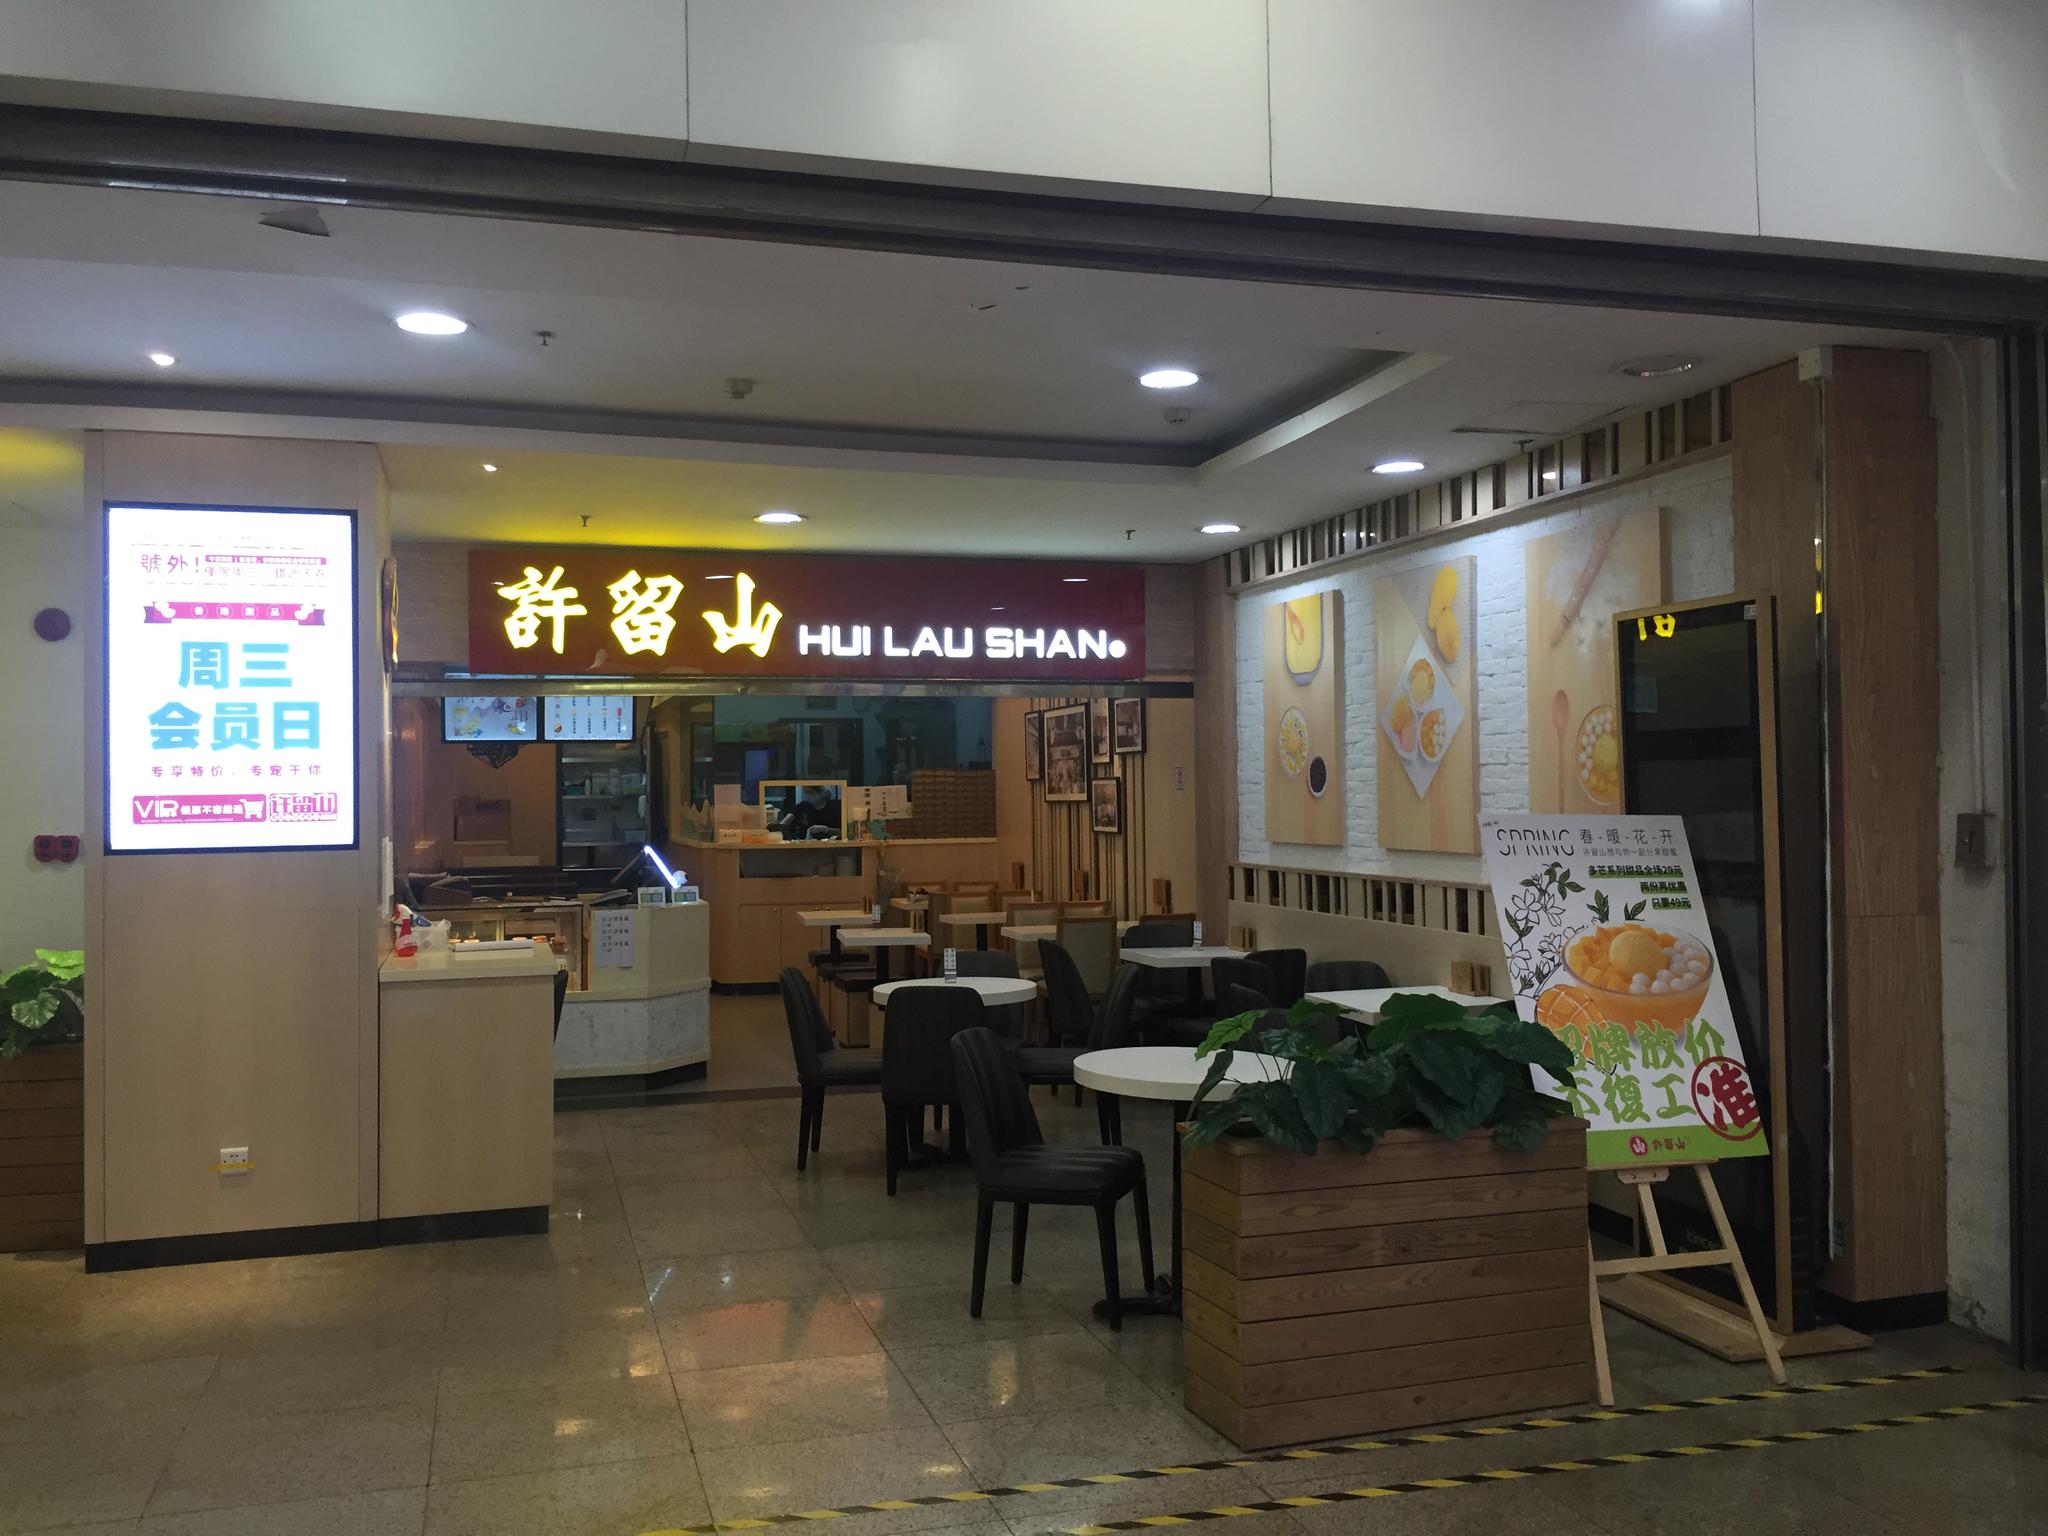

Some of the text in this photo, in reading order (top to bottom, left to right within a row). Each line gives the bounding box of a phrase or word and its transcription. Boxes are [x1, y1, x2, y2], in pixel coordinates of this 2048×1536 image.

[497, 565, 783, 659] 許留山
[178, 641, 293, 690] 周三
[798, 624, 1108, 661] HUI LAU SHAN
[148, 701, 321, 751] 会员日
[1496, 828, 1575, 857] SPRING
